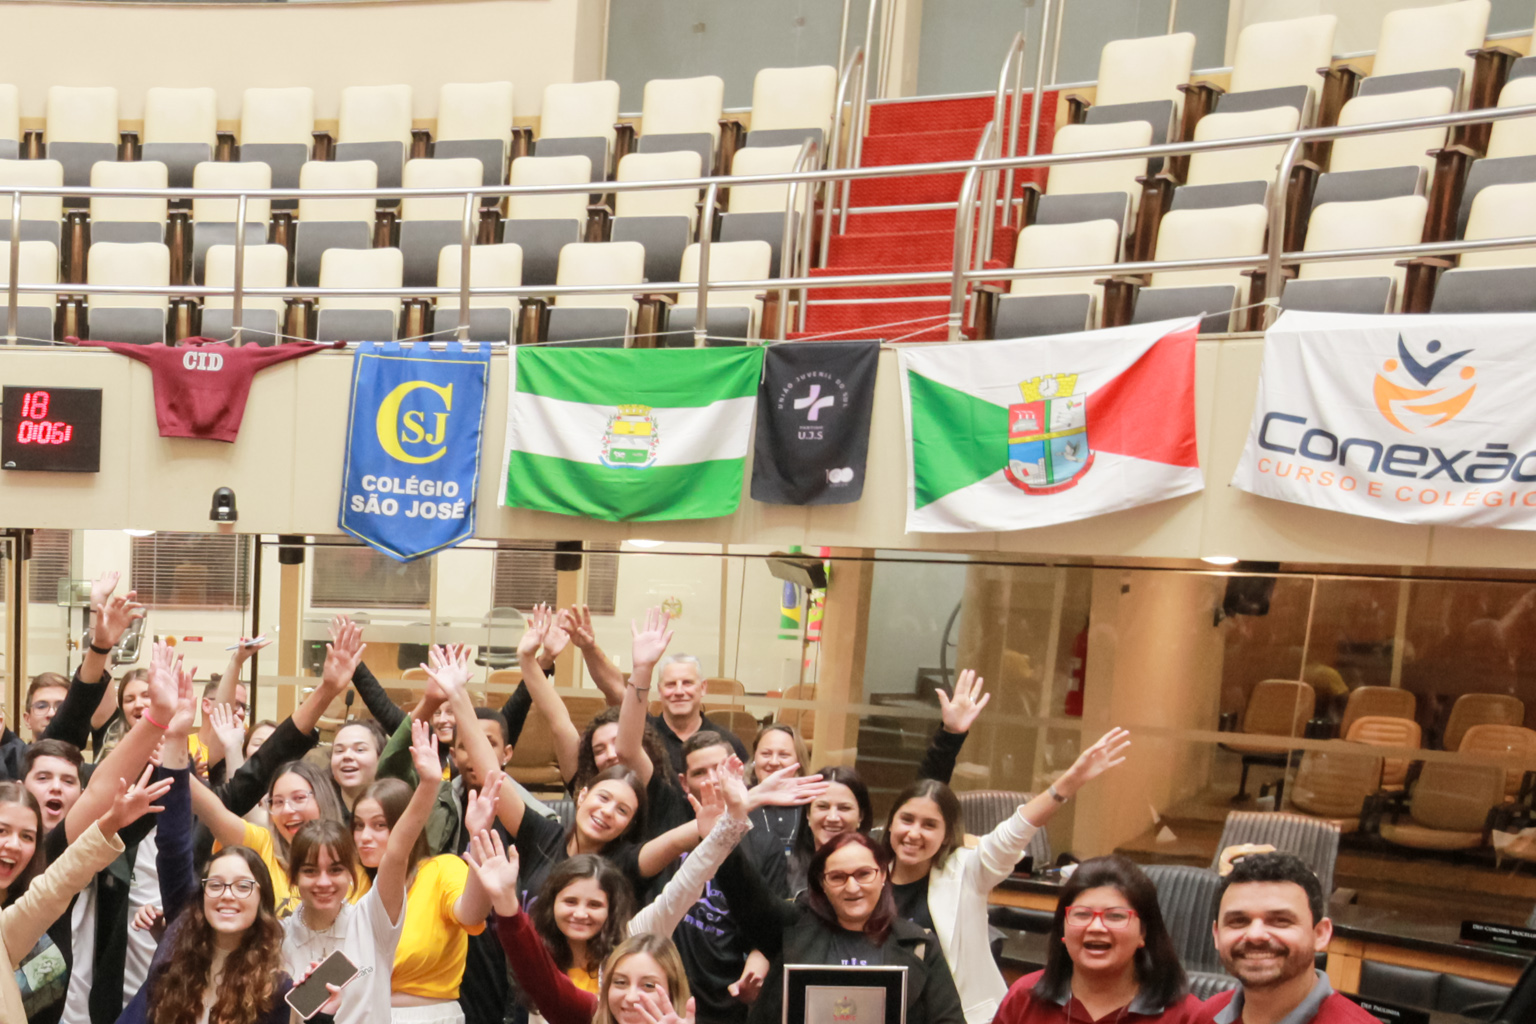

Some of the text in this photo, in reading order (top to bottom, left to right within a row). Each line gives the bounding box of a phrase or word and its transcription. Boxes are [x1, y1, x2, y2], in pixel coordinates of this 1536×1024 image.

[183, 351, 224, 371] CID
[21, 391, 51, 419] 18
[362, 475, 460, 498] COLÉGIO
[1257, 457, 1357, 492] CURSO
[1368, 480, 1384, 498] E
[350, 493, 466, 520] SÃO JOSÉ
